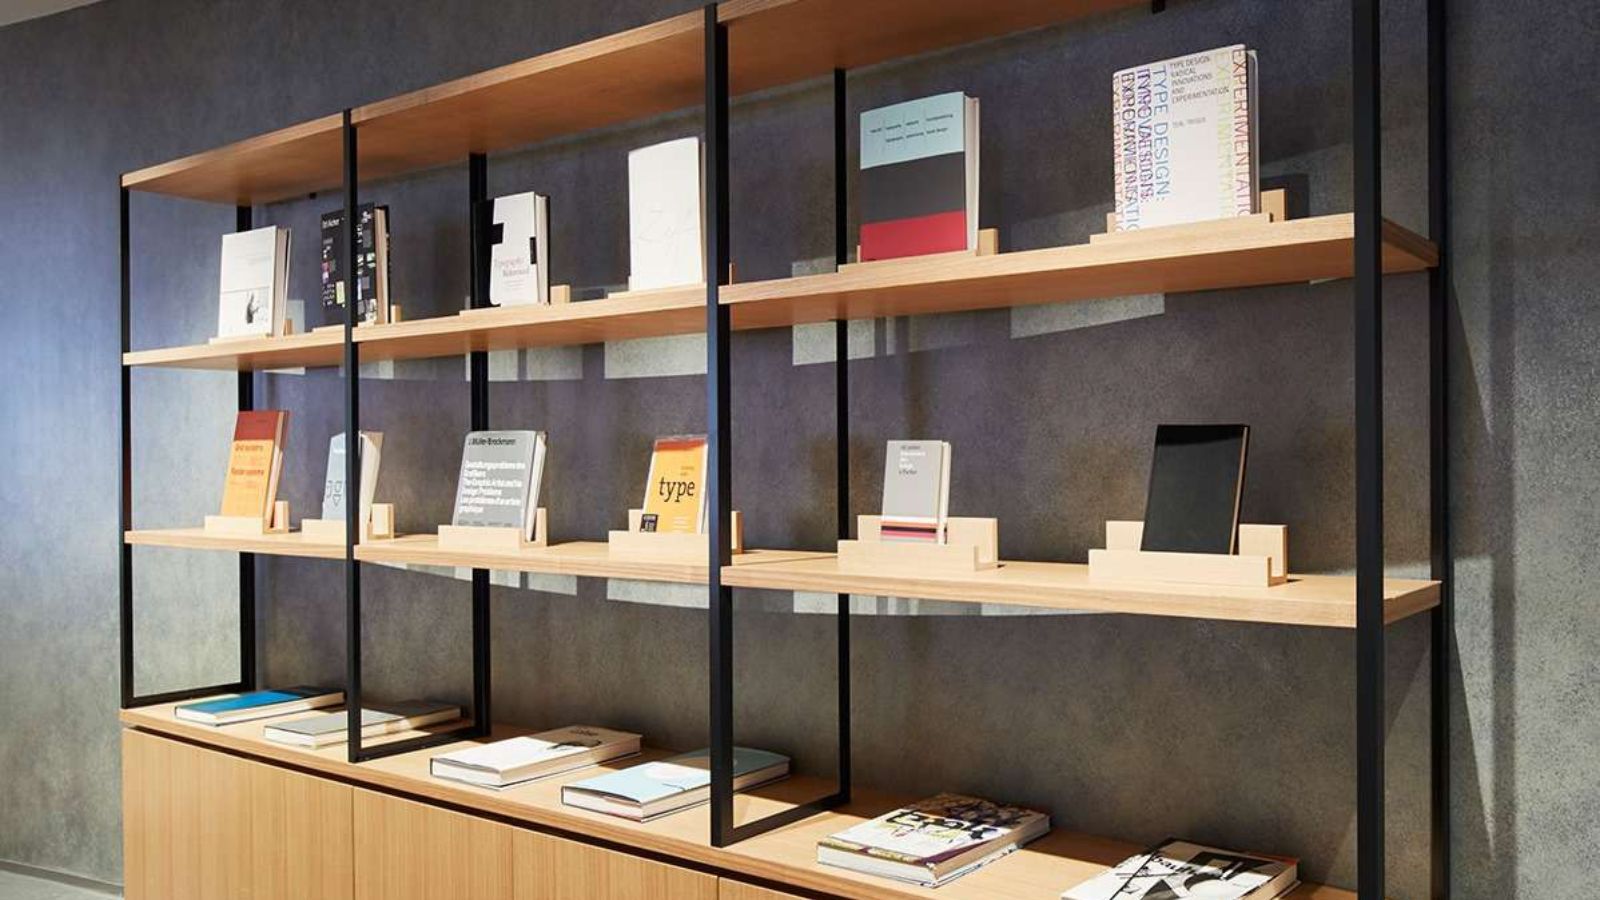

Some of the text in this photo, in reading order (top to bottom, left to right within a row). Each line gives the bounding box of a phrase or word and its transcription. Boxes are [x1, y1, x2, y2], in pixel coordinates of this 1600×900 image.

[1185, 55, 1210, 66] DESIGN
[1152, 66, 1168, 115] TYPE
[658, 475, 696, 503] type
